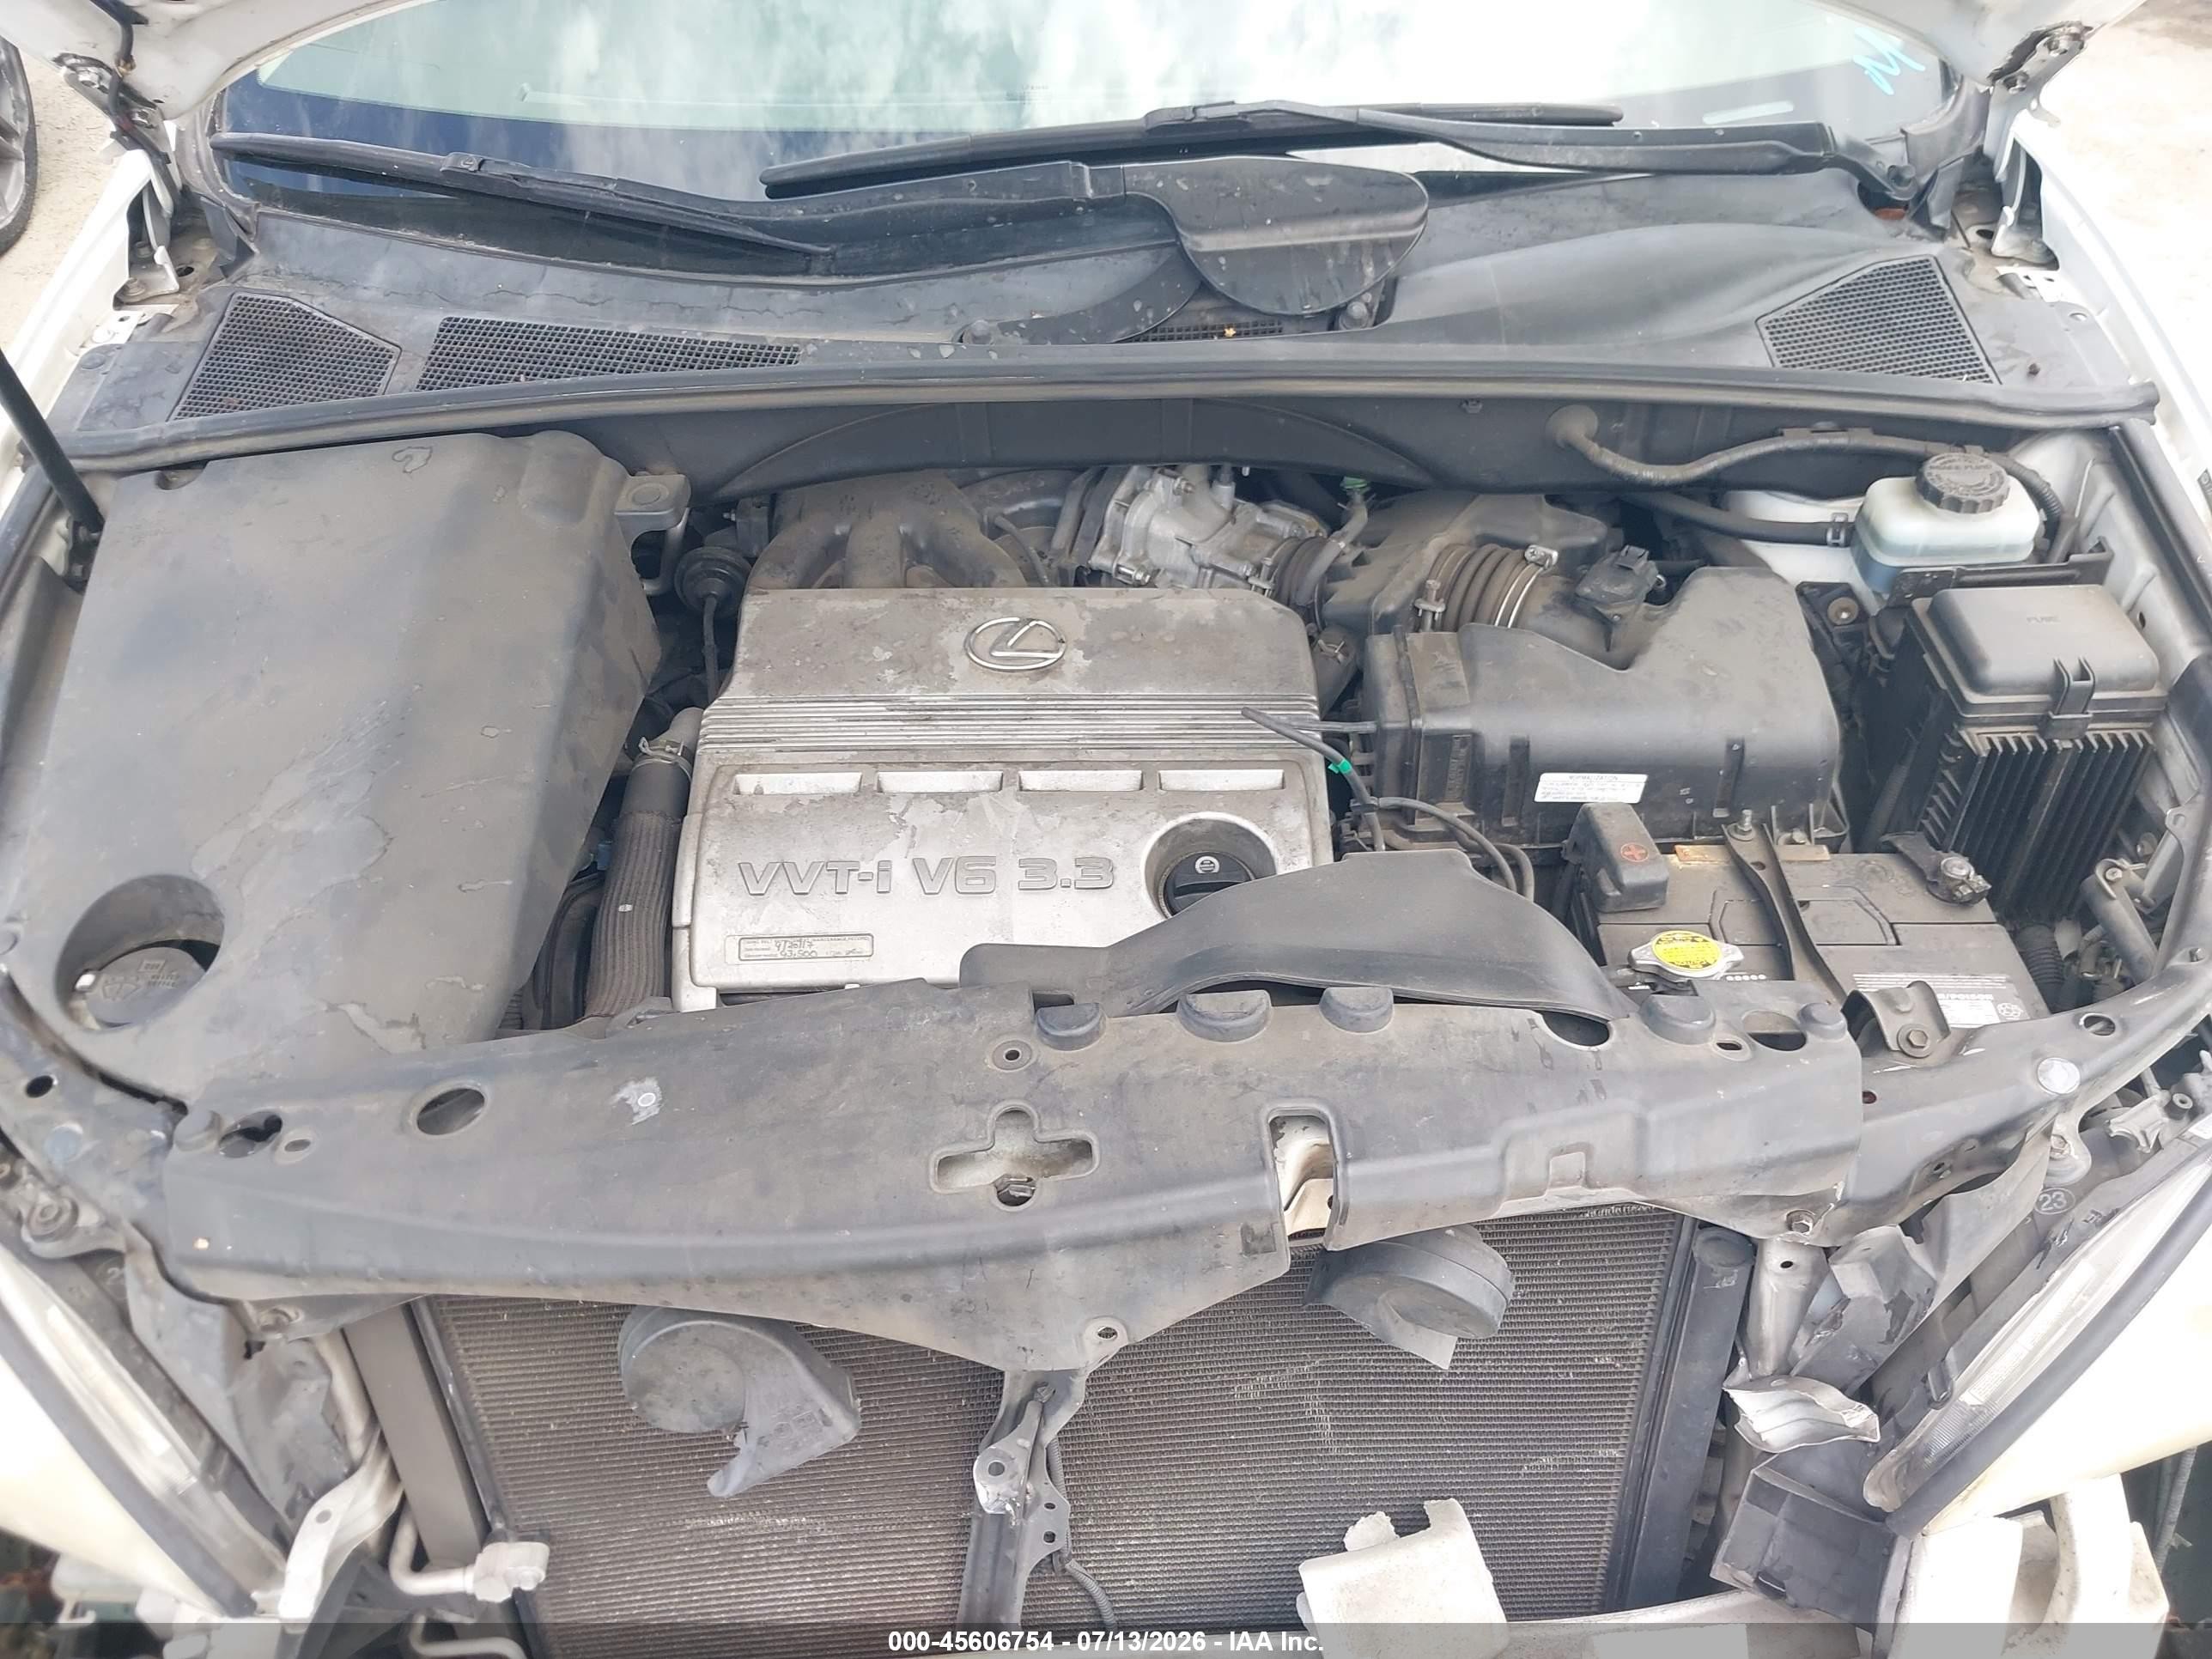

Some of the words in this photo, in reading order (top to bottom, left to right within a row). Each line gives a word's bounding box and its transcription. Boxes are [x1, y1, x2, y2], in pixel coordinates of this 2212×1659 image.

[738, 860, 892, 896] VVT-i
[912, 856, 997, 895] V6
[1018, 856, 1115, 890] 3.3
[2038, 1191, 2068, 1212] 23
